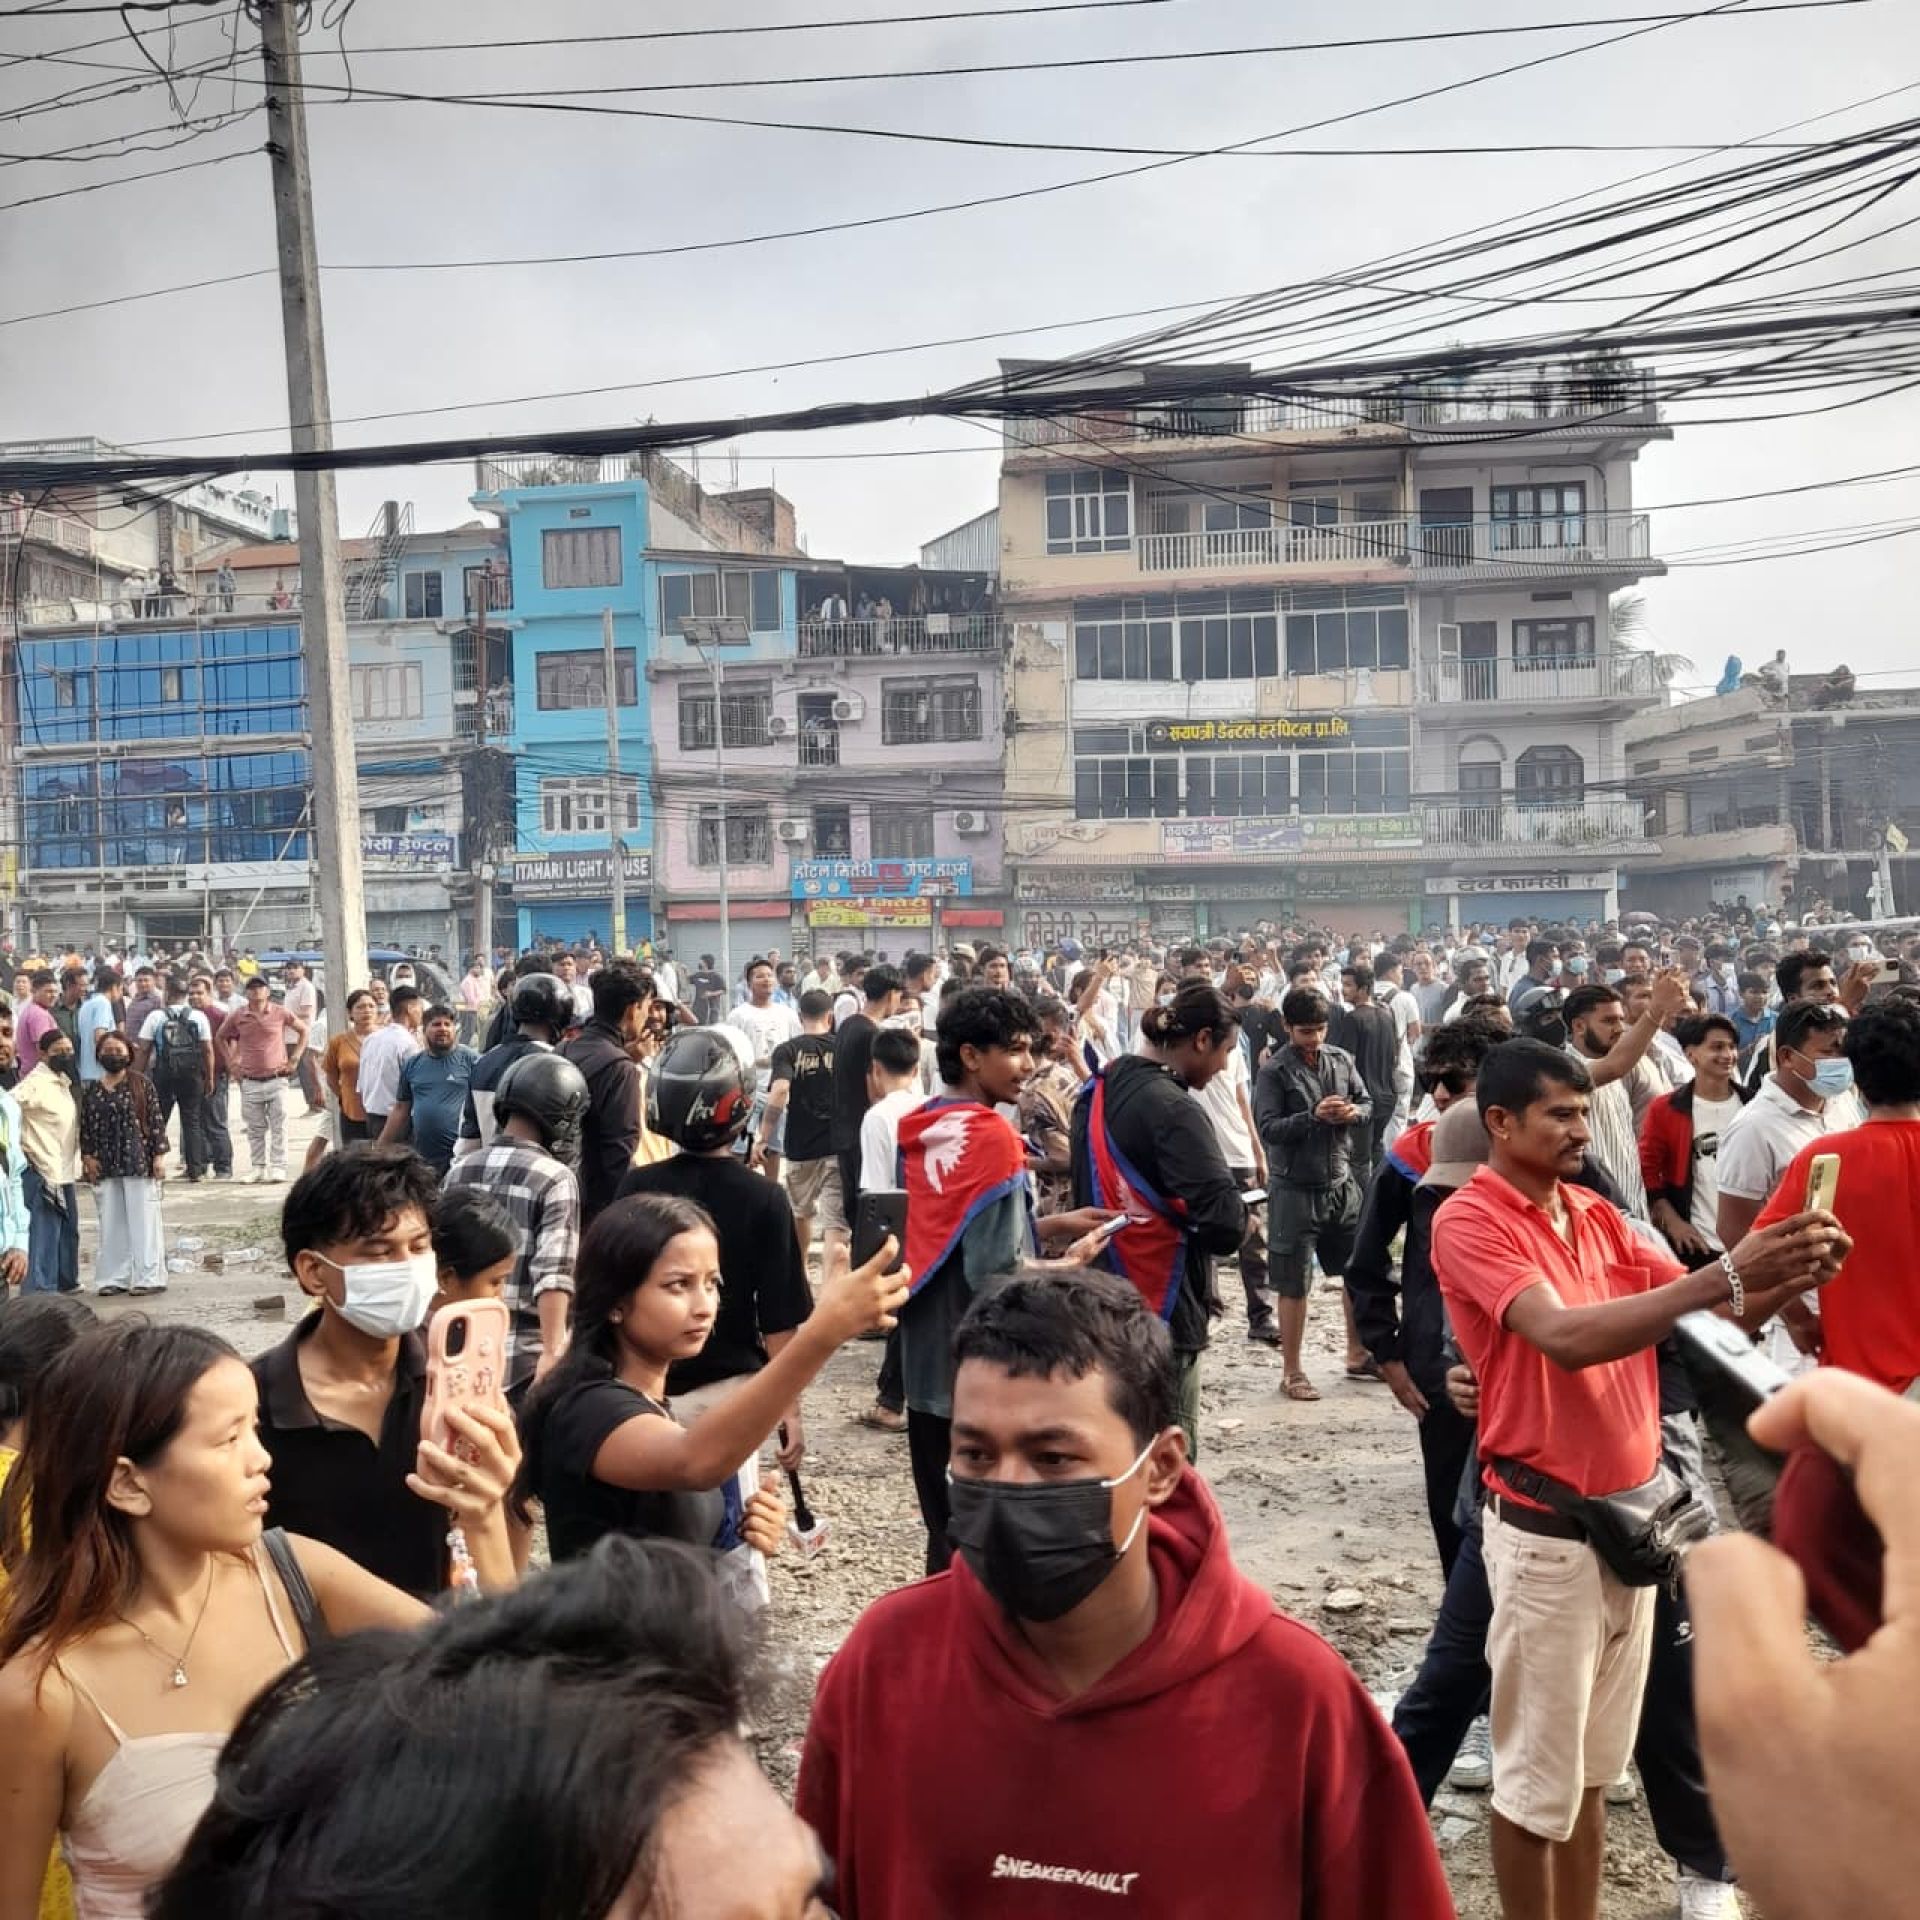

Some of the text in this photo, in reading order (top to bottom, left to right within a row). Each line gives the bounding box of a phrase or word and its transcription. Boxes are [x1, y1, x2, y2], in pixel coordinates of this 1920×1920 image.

[515, 857, 649, 881] ITAHARI LIGHT HUSE
[991, 1854, 1140, 1895] SNEAKERVAULT
